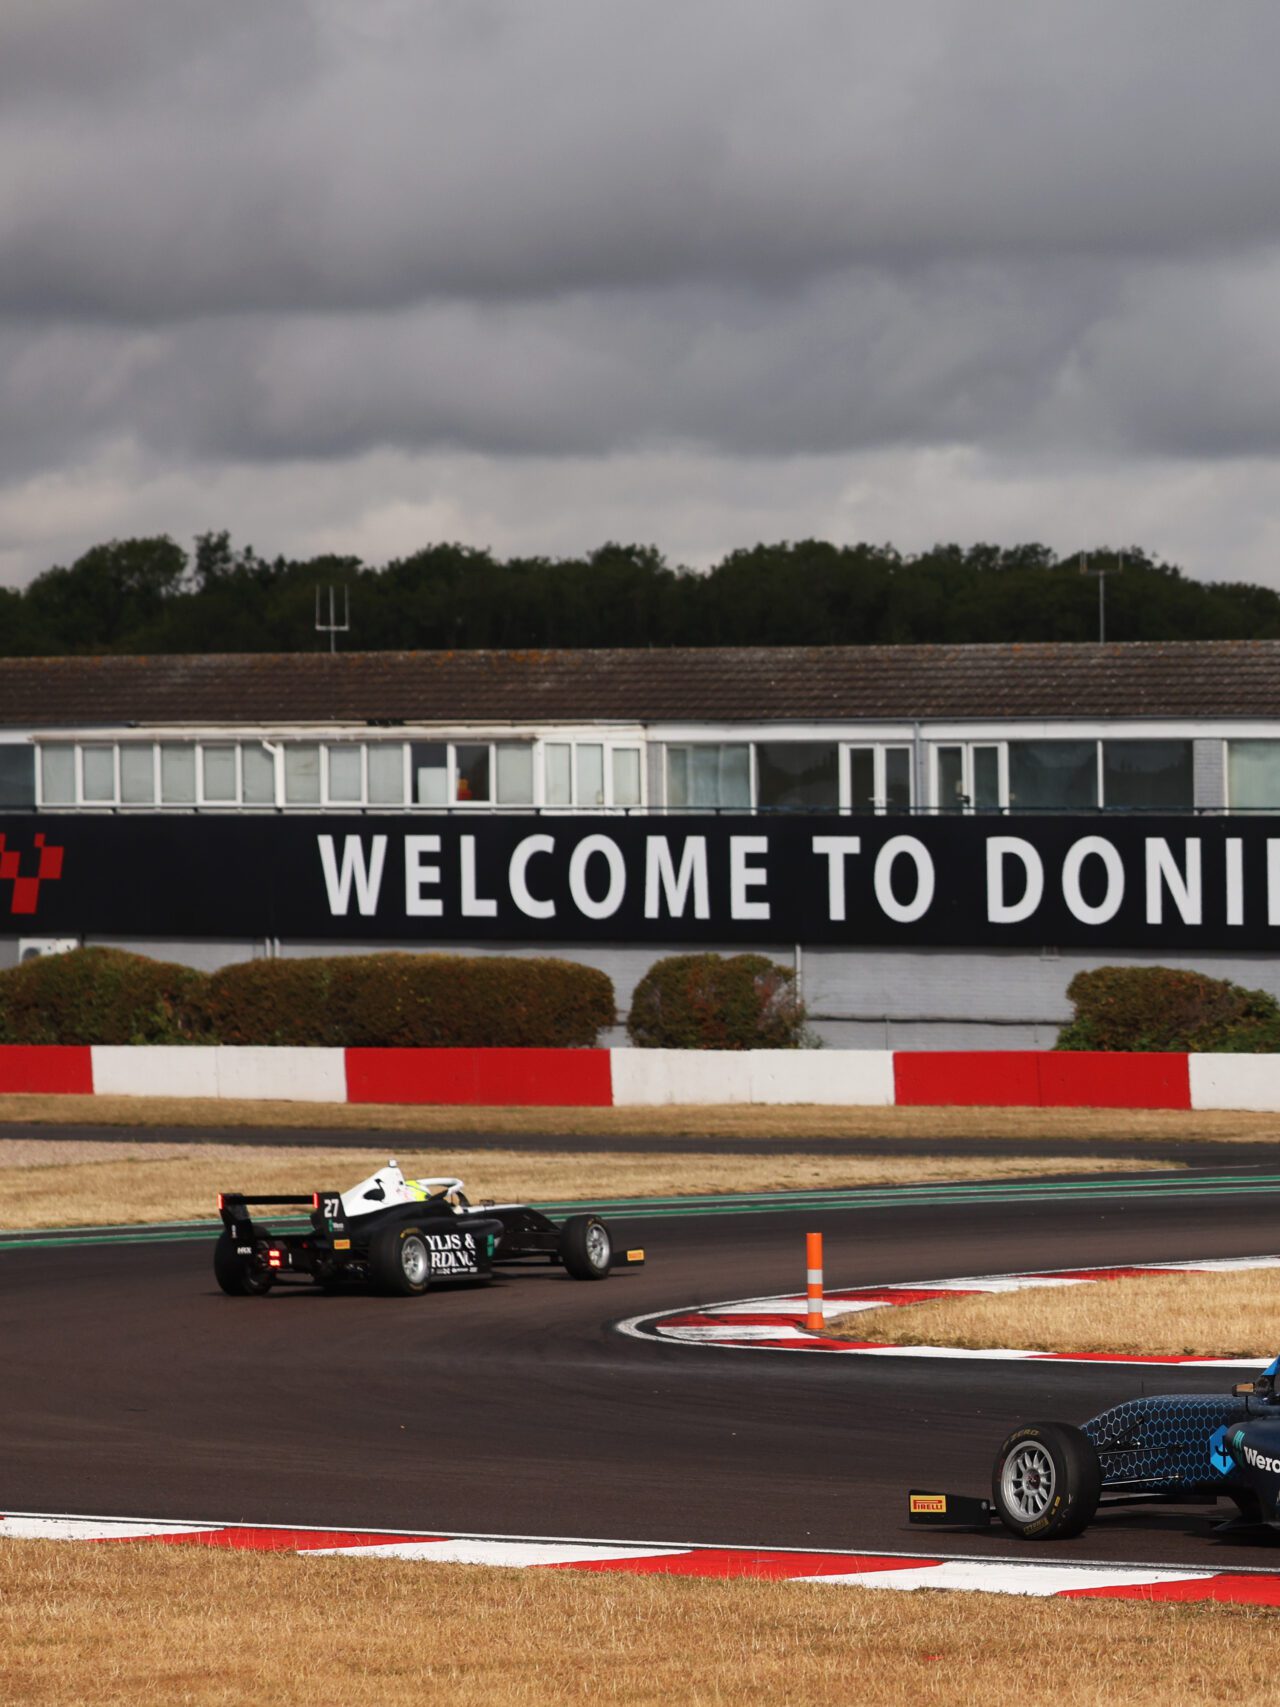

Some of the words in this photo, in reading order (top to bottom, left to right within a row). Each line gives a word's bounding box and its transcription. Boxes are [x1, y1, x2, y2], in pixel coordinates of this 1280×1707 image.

[317, 833, 771, 924] WELCOME
[812, 834, 935, 926] TO
[323, 1198, 340, 1218] 27
[465, 1233, 476, 1249] &
[913, 1500, 943, 1510] PIRELLI
